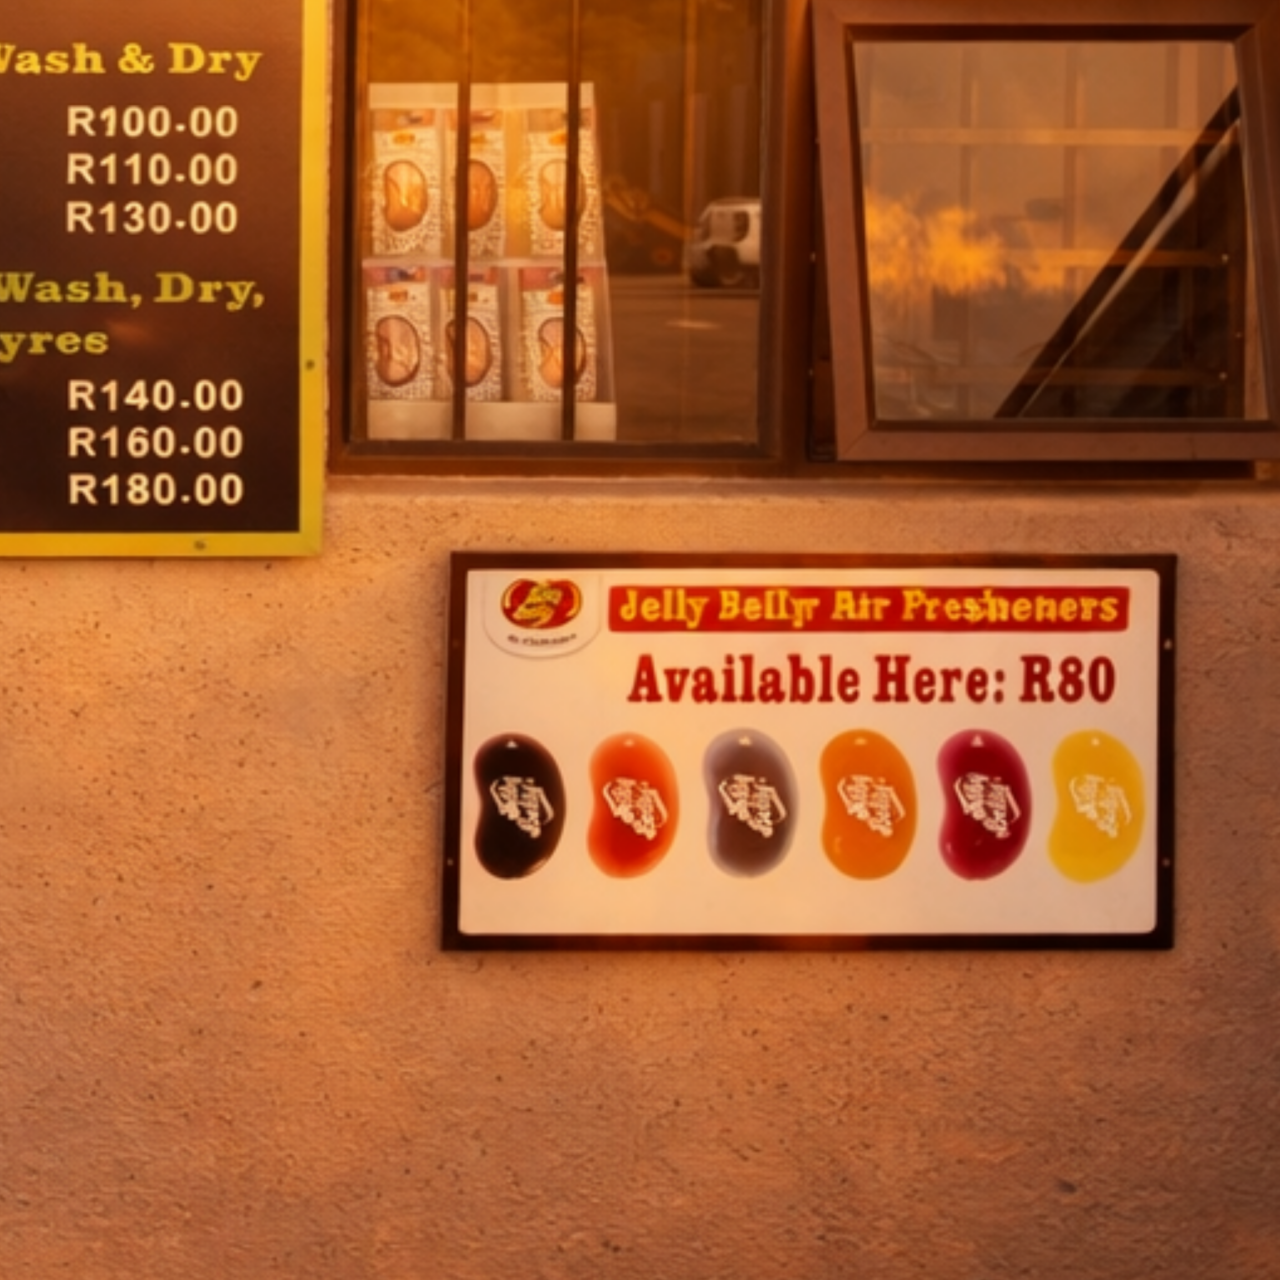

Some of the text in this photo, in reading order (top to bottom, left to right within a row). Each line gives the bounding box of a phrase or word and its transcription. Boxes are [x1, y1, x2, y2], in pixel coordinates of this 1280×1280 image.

[119, 43, 156, 74] &
[169, 43, 264, 82] Dry
[154, 272, 266, 313] Dry,
[620, 588, 709, 630] Jelly
[831, 589, 892, 621] Air
[627, 654, 1117, 705] Available Here: R80
